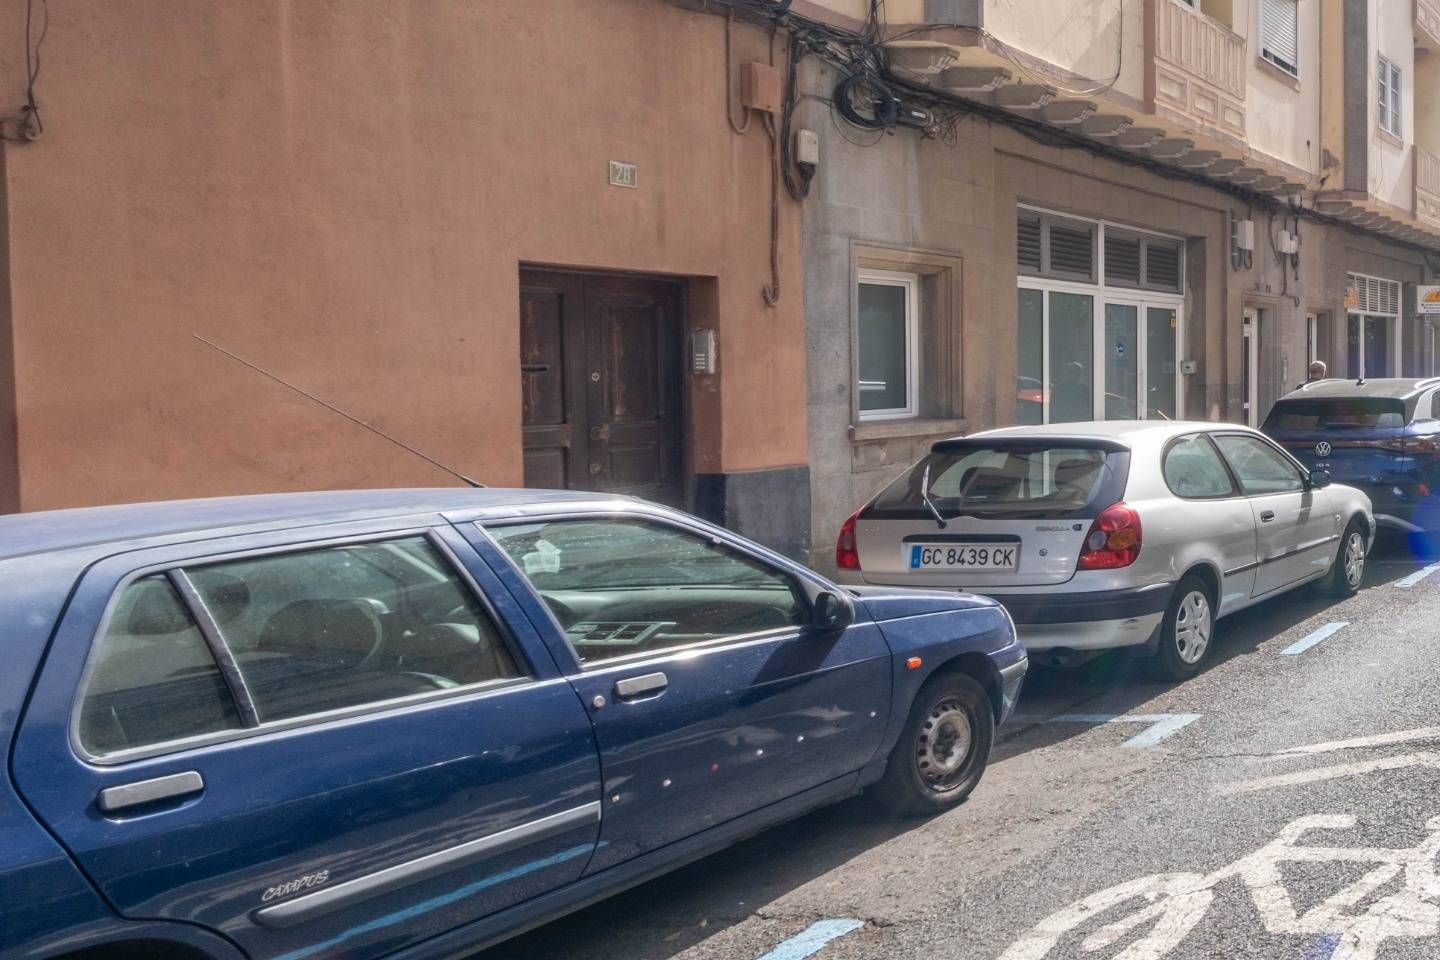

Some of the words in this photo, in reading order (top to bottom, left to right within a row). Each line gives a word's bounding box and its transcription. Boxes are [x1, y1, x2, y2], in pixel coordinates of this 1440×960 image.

[921, 549, 943, 565] GC
[946, 549, 989, 565] 8439
[992, 549, 1014, 565] CK
[262, 870, 330, 901] CAMPUS
